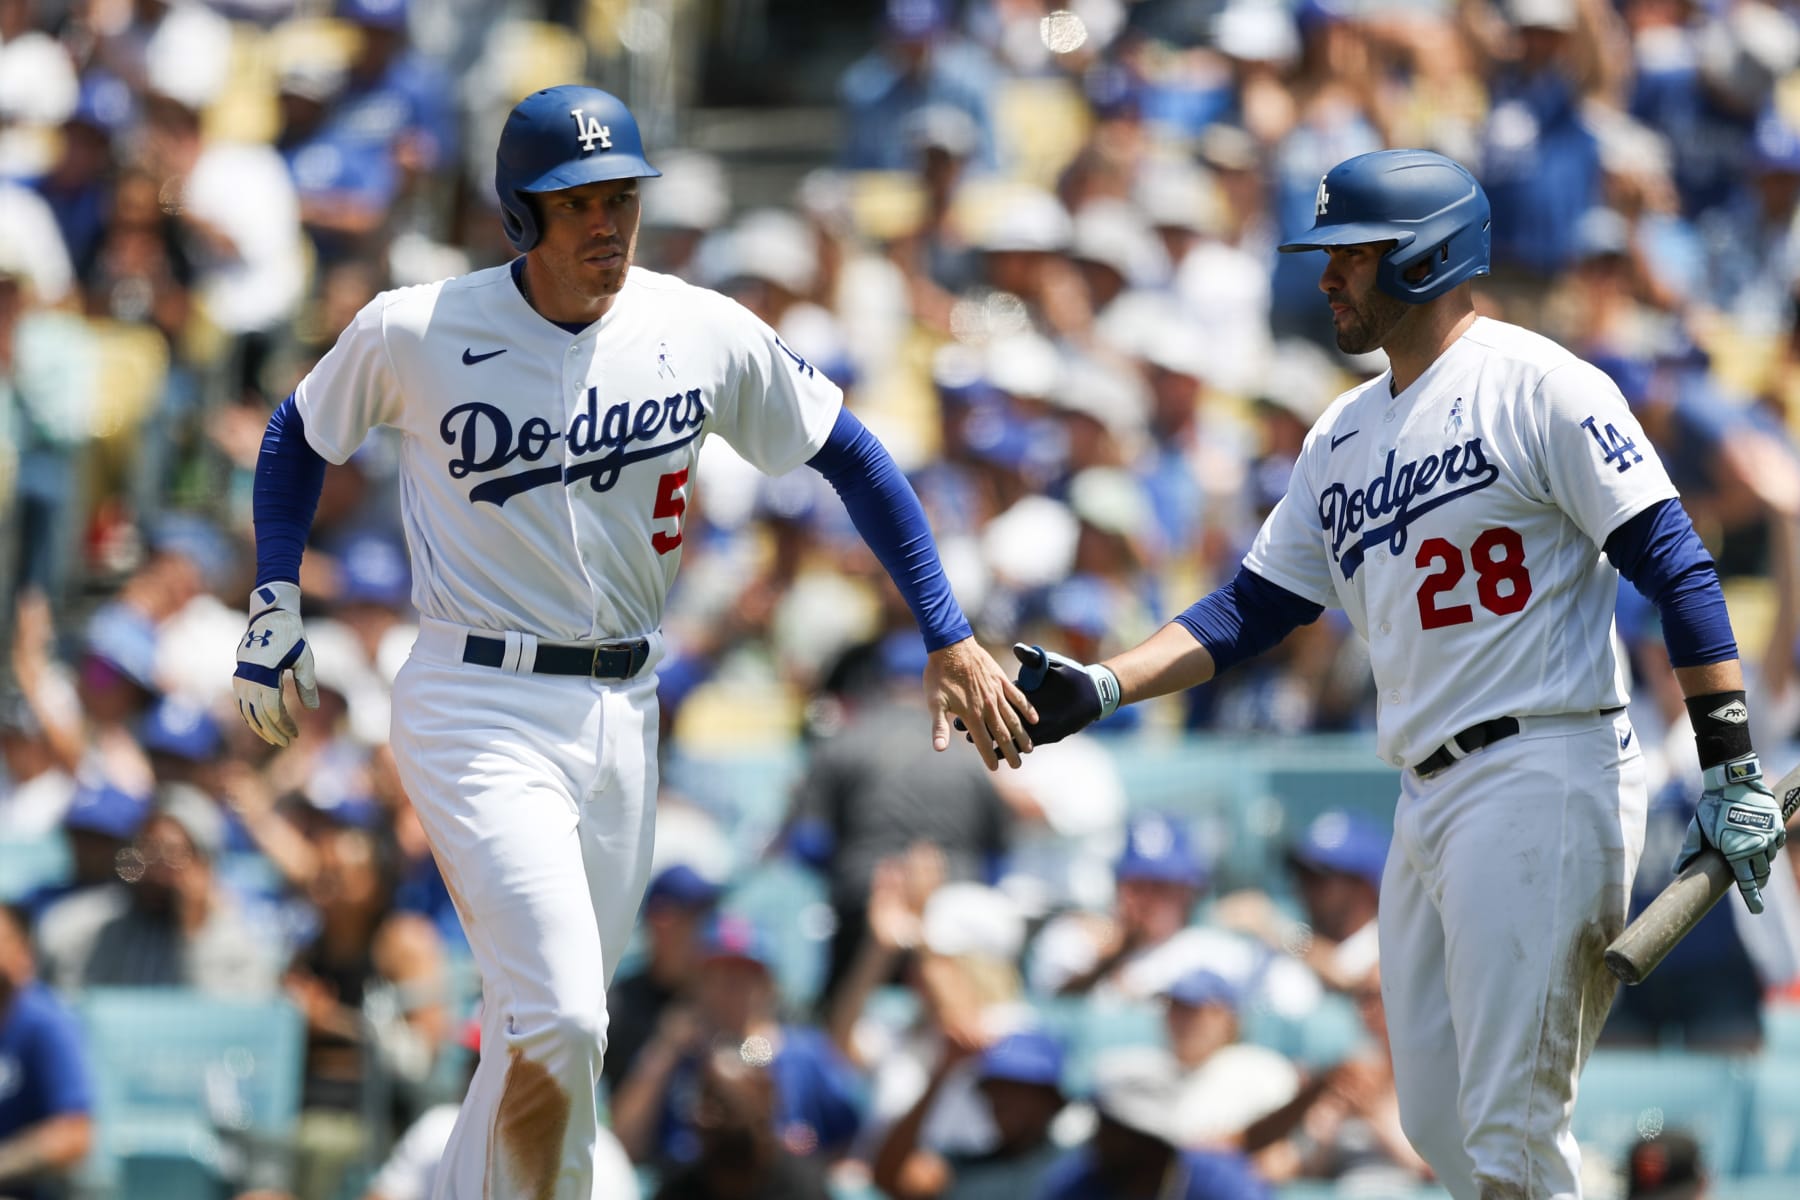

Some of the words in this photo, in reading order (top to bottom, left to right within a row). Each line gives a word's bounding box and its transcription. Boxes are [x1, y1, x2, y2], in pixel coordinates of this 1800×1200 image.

[571, 109, 612, 151] LA
[440, 386, 706, 507] Dodgers
[1580, 416, 1644, 473] LA
[651, 467, 689, 555] 5
[1319, 437, 1499, 580] Dodgers
[1415, 526, 1532, 630] 28
